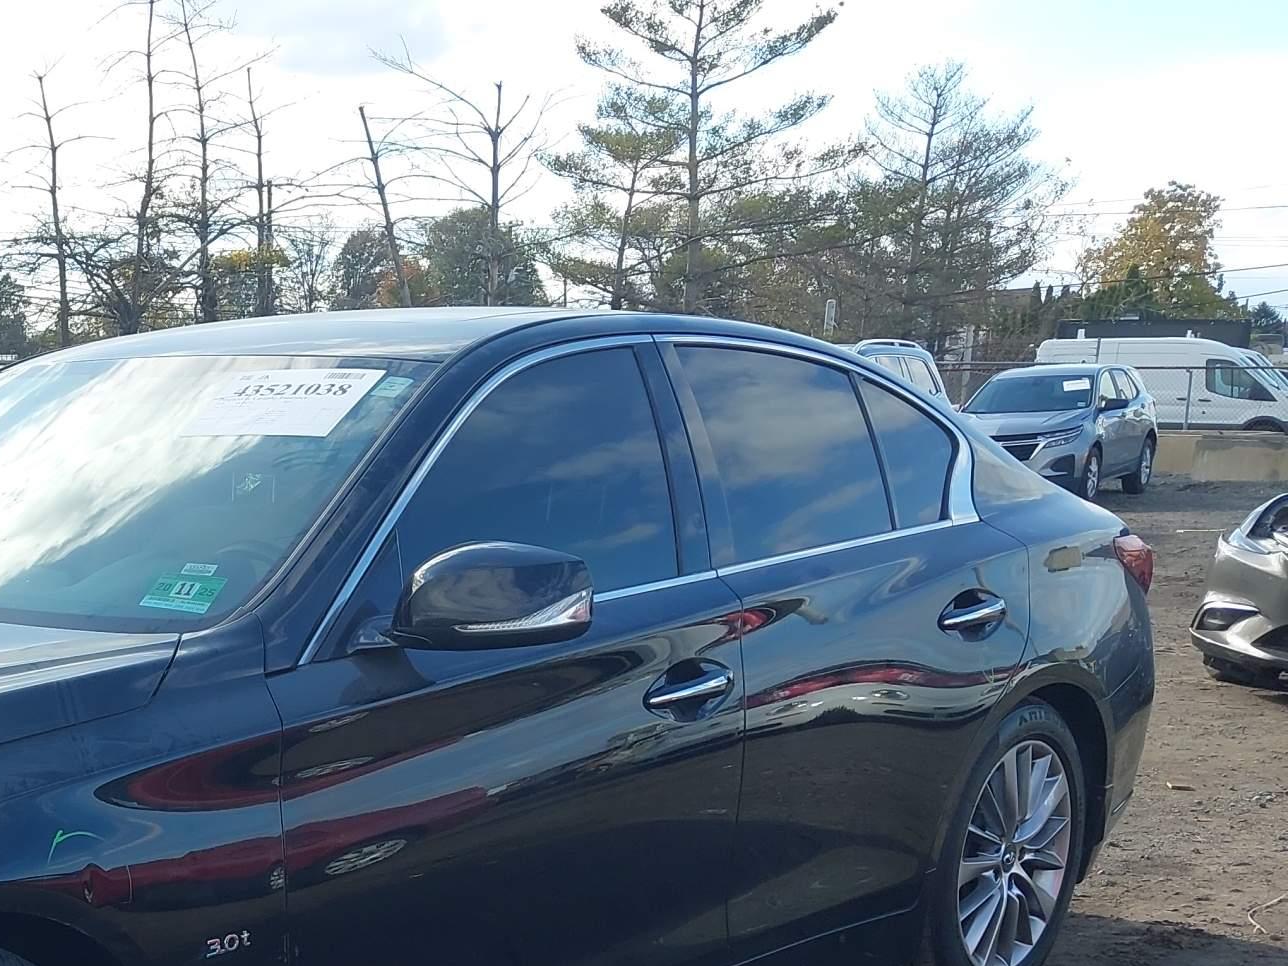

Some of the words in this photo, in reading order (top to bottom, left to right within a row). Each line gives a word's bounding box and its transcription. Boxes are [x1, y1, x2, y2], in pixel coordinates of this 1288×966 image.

[233, 382, 353, 397] 43521038
[155, 582, 170, 592] 20
[174, 582, 195, 596] 11
[198, 587, 216, 597] 25
[206, 930, 251, 958] 3.0t
